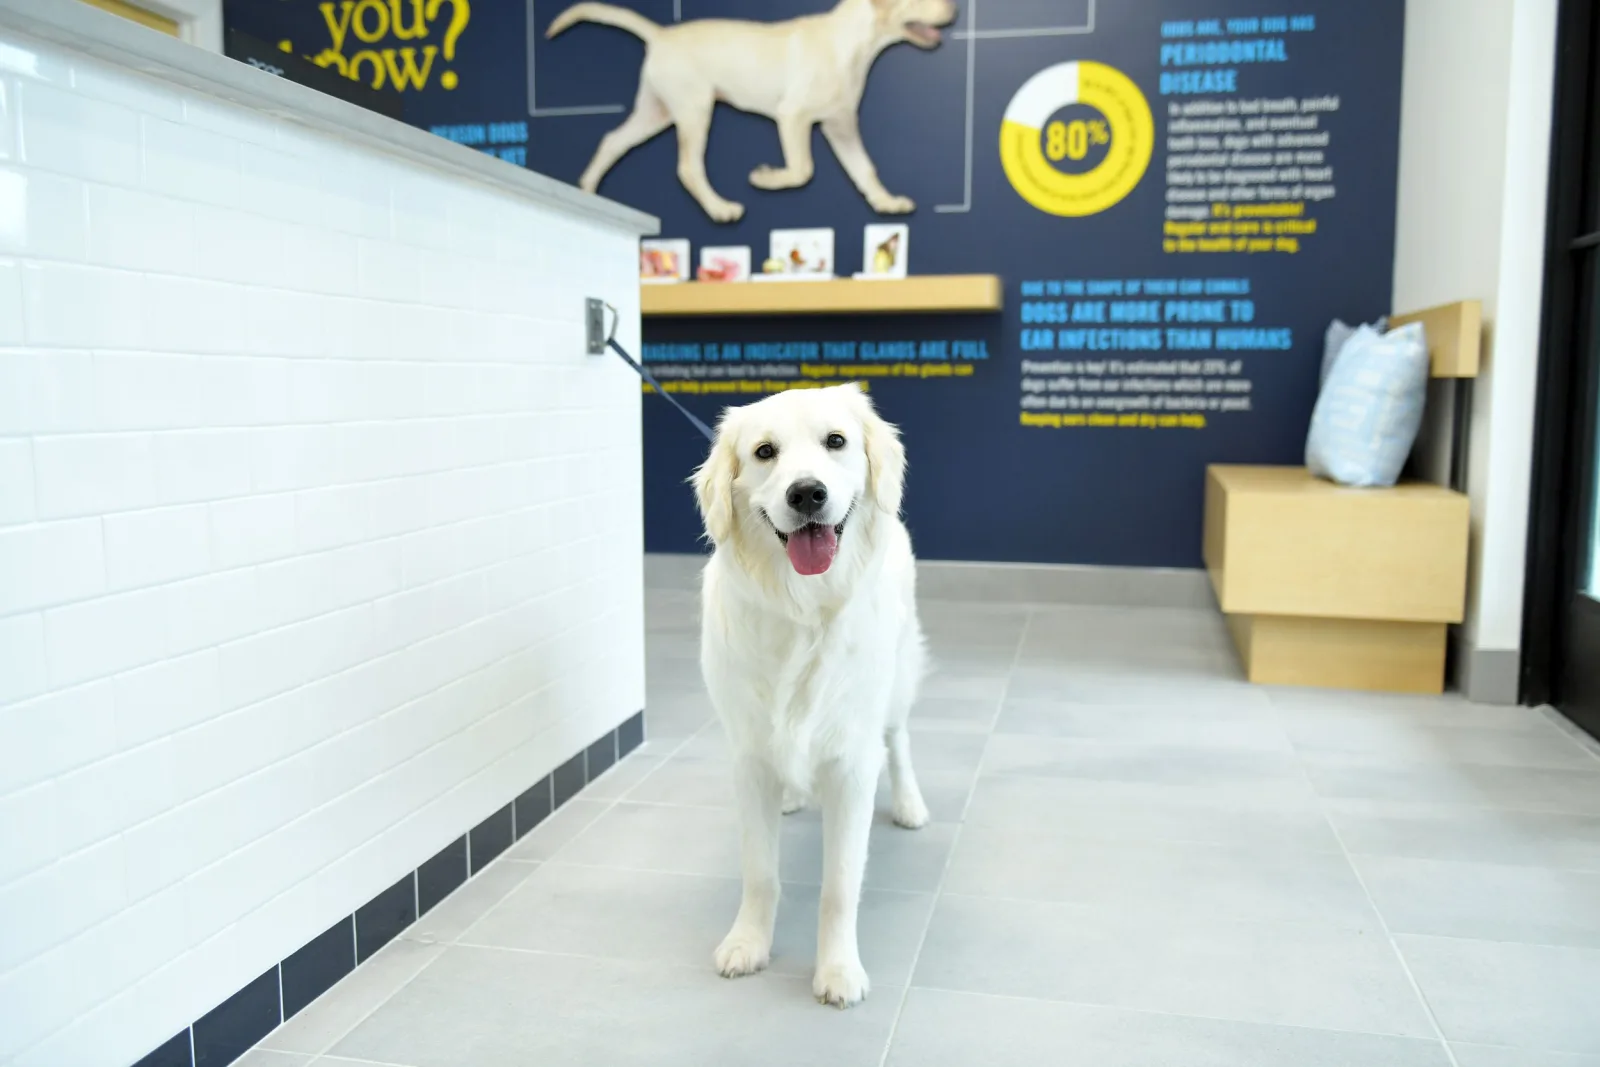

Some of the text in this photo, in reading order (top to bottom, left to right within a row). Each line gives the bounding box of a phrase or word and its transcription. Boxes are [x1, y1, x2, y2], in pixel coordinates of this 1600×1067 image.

[1227, 17, 1259, 35] YOUR
[1261, 17, 1287, 33] DOG
[1160, 39, 1287, 66] PERIODONTAL
[1159, 69, 1238, 94] DISEASE
[1301, 96, 1339, 113] painful
[1046, 119, 1109, 161] 80%
[1021, 300, 1254, 323] DOGS ARE MORE PRONE TO
[823, 340, 856, 360] THAT
[919, 340, 947, 360] ARE
[952, 340, 989, 359] FULL
[1021, 328, 1292, 350] EAR INFECTIONS THAN HUMANS
